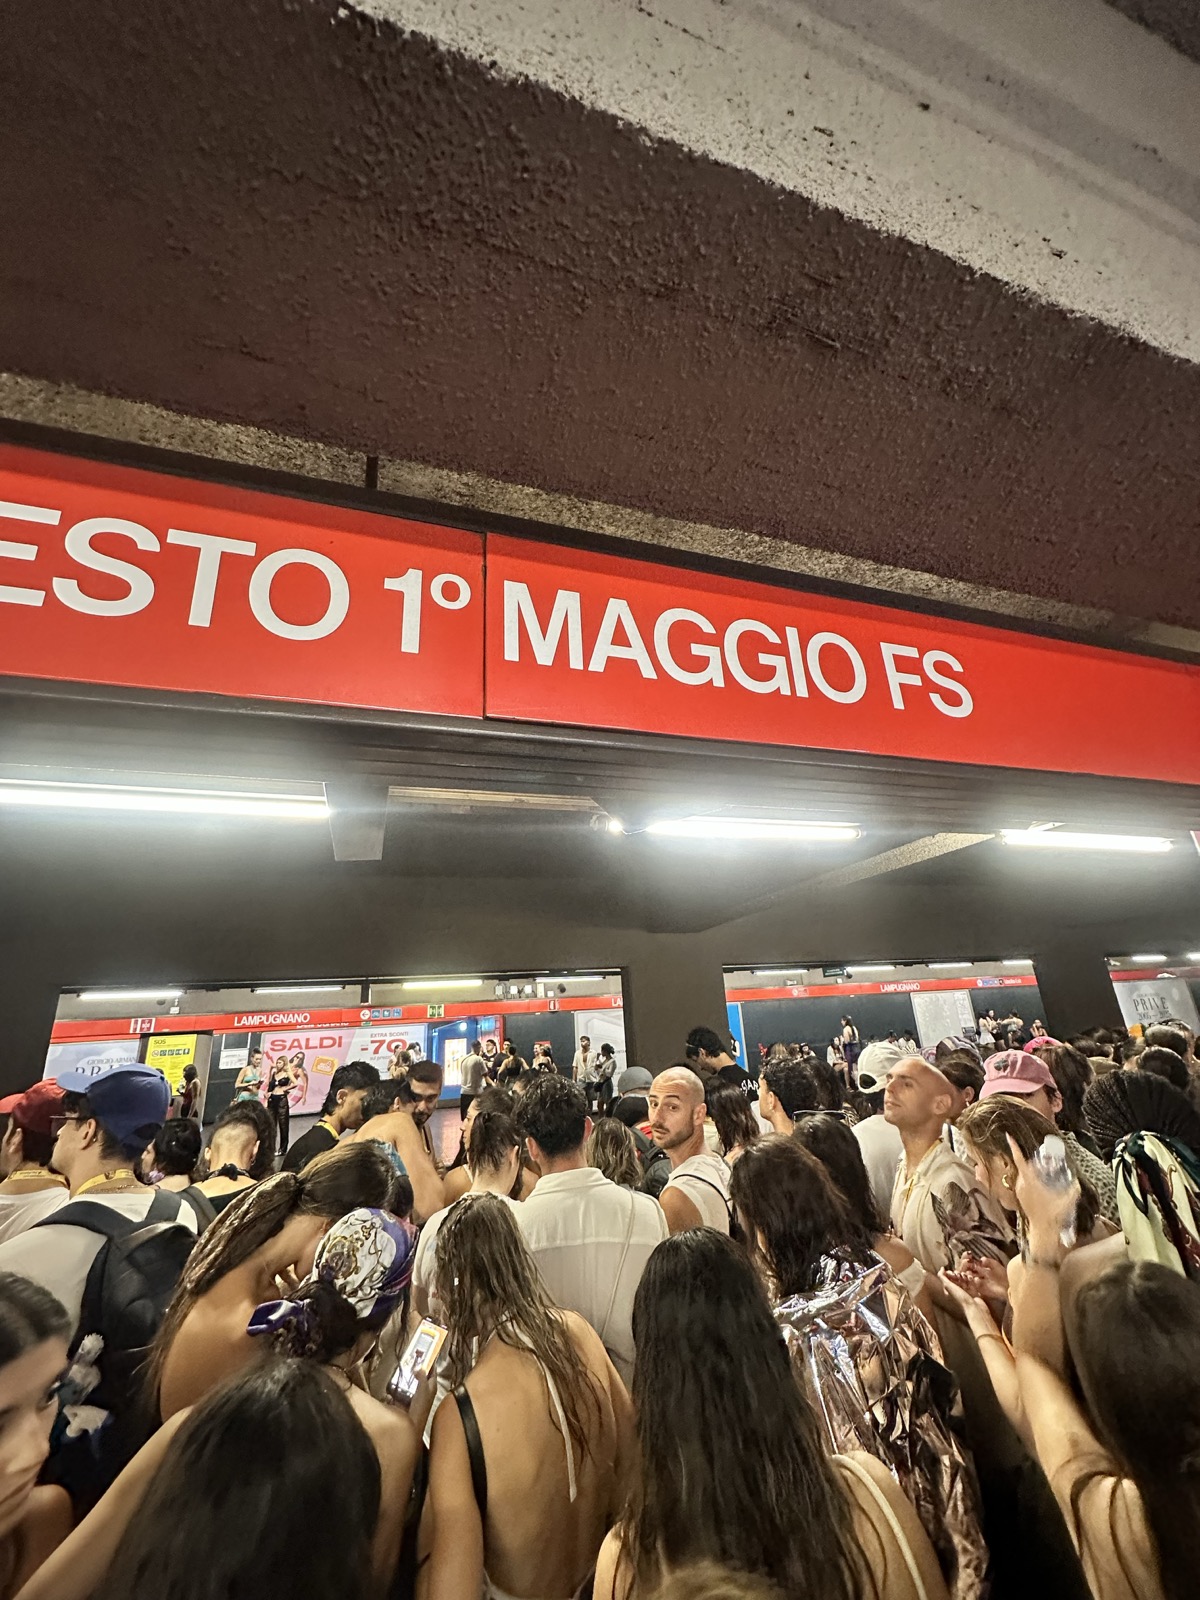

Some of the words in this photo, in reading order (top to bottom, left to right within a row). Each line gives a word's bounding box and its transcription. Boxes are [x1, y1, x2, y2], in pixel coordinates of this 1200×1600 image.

[0, 502, 350, 641] ESTO
[504, 580, 867, 704] MAGGIO
[880, 641, 974, 718] FS
[880, 982, 921, 992] LAMPUGNANO
[234, 1013, 311, 1026] LAMPUGNANO
[269, 1035, 343, 1052] SALDI
